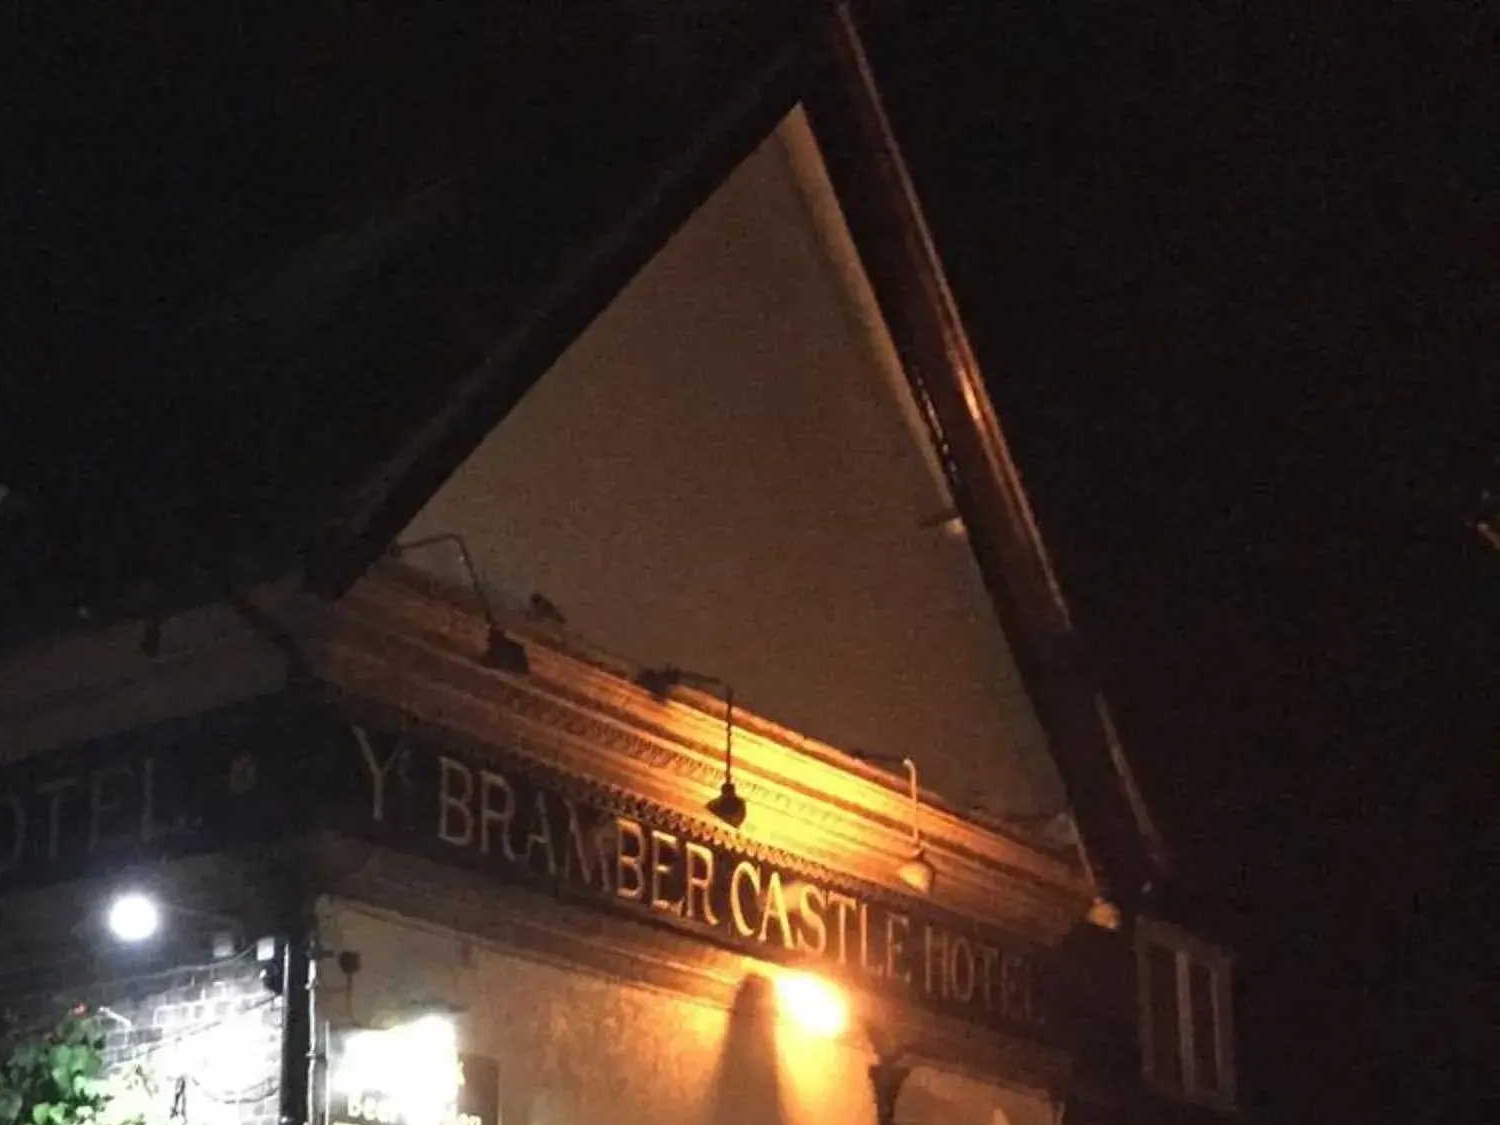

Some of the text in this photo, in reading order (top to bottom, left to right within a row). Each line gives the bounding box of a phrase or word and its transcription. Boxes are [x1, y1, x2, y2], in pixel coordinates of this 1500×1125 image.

[436, 754, 720, 927] BRAMBER
[730, 860, 913, 985] CASTLE
[924, 922, 1047, 1024] HOTEL
